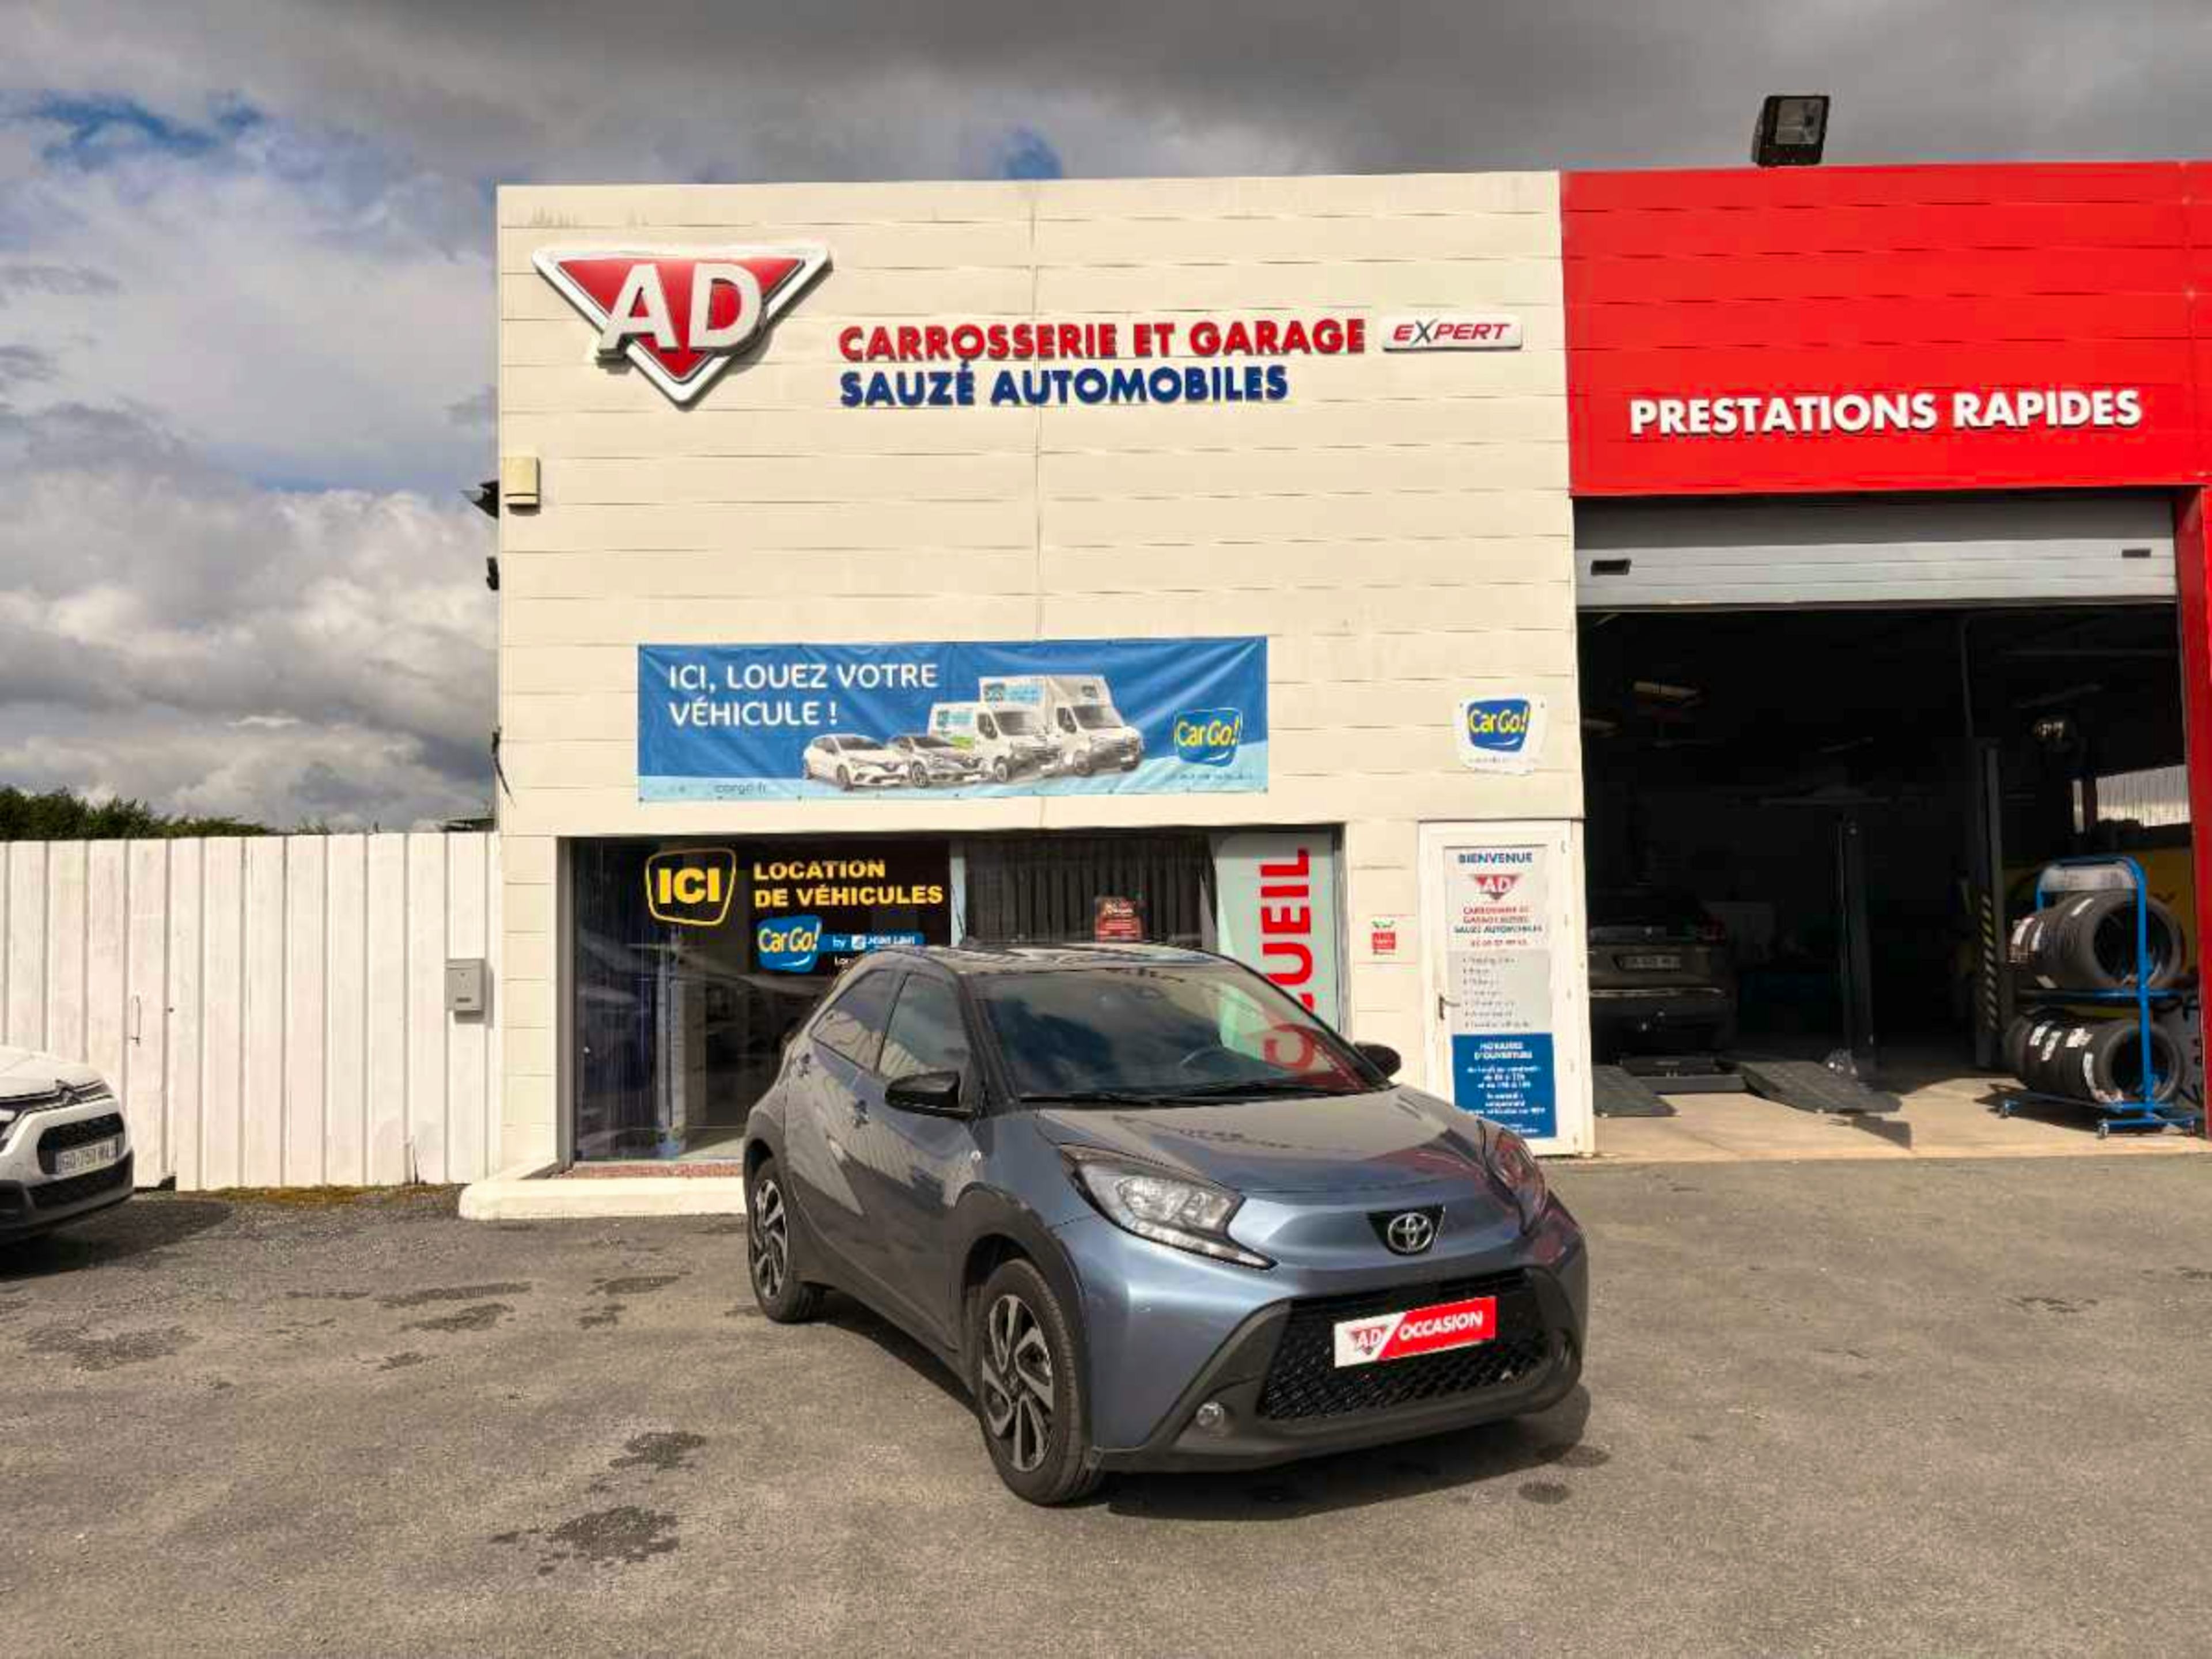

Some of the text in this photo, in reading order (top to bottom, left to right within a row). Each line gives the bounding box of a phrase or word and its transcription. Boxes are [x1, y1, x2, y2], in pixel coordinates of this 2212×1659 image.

[597, 262, 766, 353] AD
[838, 318, 1365, 362] CARROSSERIE ET GARAGE
[840, 361, 1288, 406] SAUZÉ AUTOMOBILES
[1630, 389, 2143, 435] PRESTATIONS RAPIDES
[669, 663, 939, 694] ICI, LOUEZ VOTRE
[669, 695, 820, 726] VÉHICULE
[753, 860, 886, 881] LOCATION
[1459, 852, 1533, 863] BIENVENUE
[658, 868, 721, 904] ICI
[755, 884, 944, 908] DE VÉHICULES
[1357, 1310, 1483, 1347] AD OCCASION
